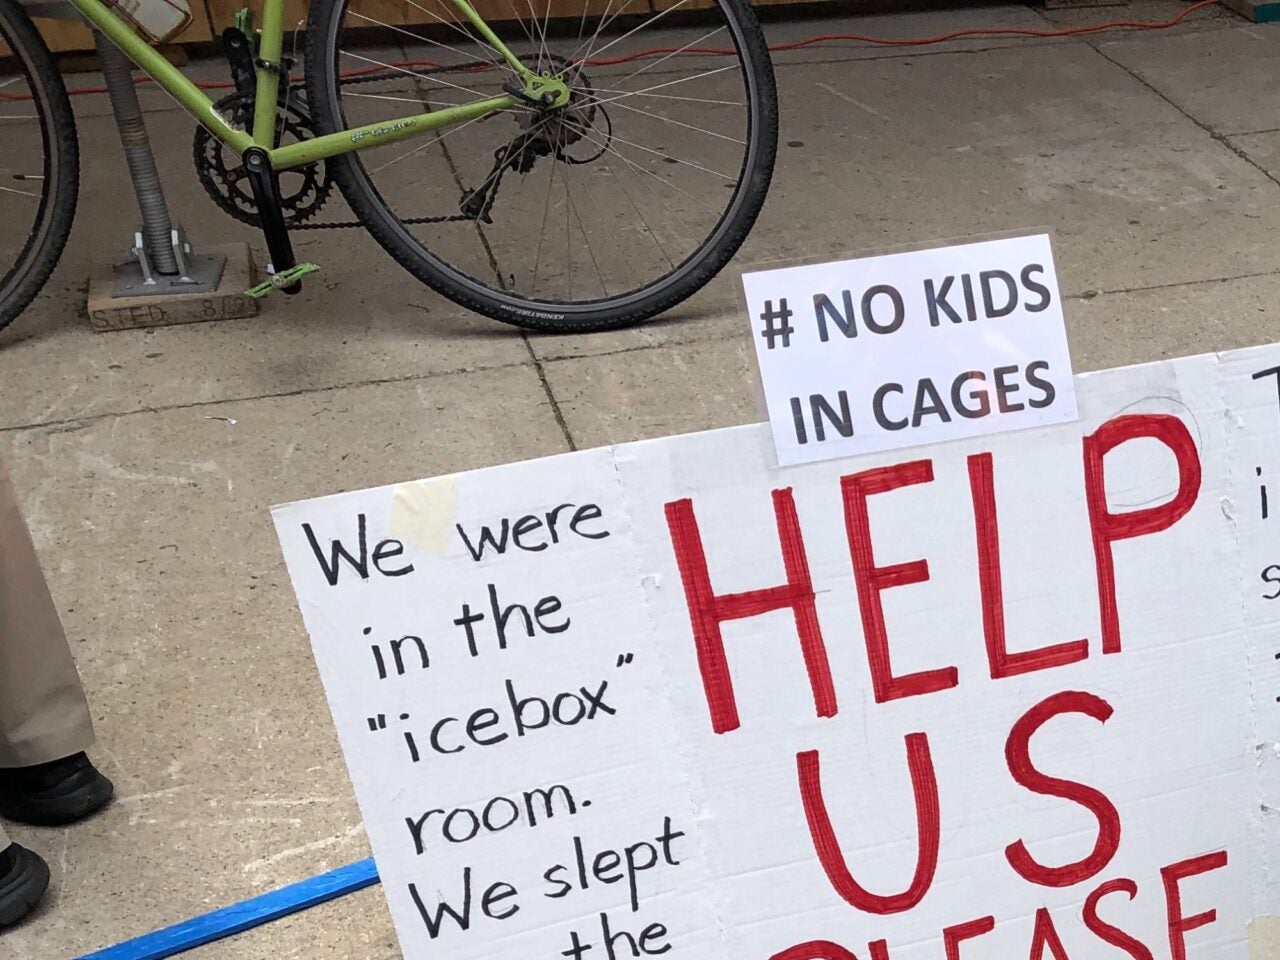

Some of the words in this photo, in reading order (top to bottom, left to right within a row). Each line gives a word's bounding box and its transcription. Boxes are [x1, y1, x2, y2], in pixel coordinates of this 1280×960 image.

[760, 298, 795, 349] #
[813, 284, 905, 343] NO
[924, 263, 1051, 327] KIDS
[789, 390, 854, 445] IN
[872, 360, 1056, 431] CAGES
[301, 513, 415, 586] We
[456, 503, 610, 562] were
[664, 413, 1202, 734] HELP
[363, 626, 429, 679] in
[454, 583, 571, 657] the
[367, 652, 634, 762] "icebox"
[405, 784, 592, 855] room.
[796, 690, 1121, 915] US
[408, 866, 520, 938] We
[543, 816, 685, 912] slept
